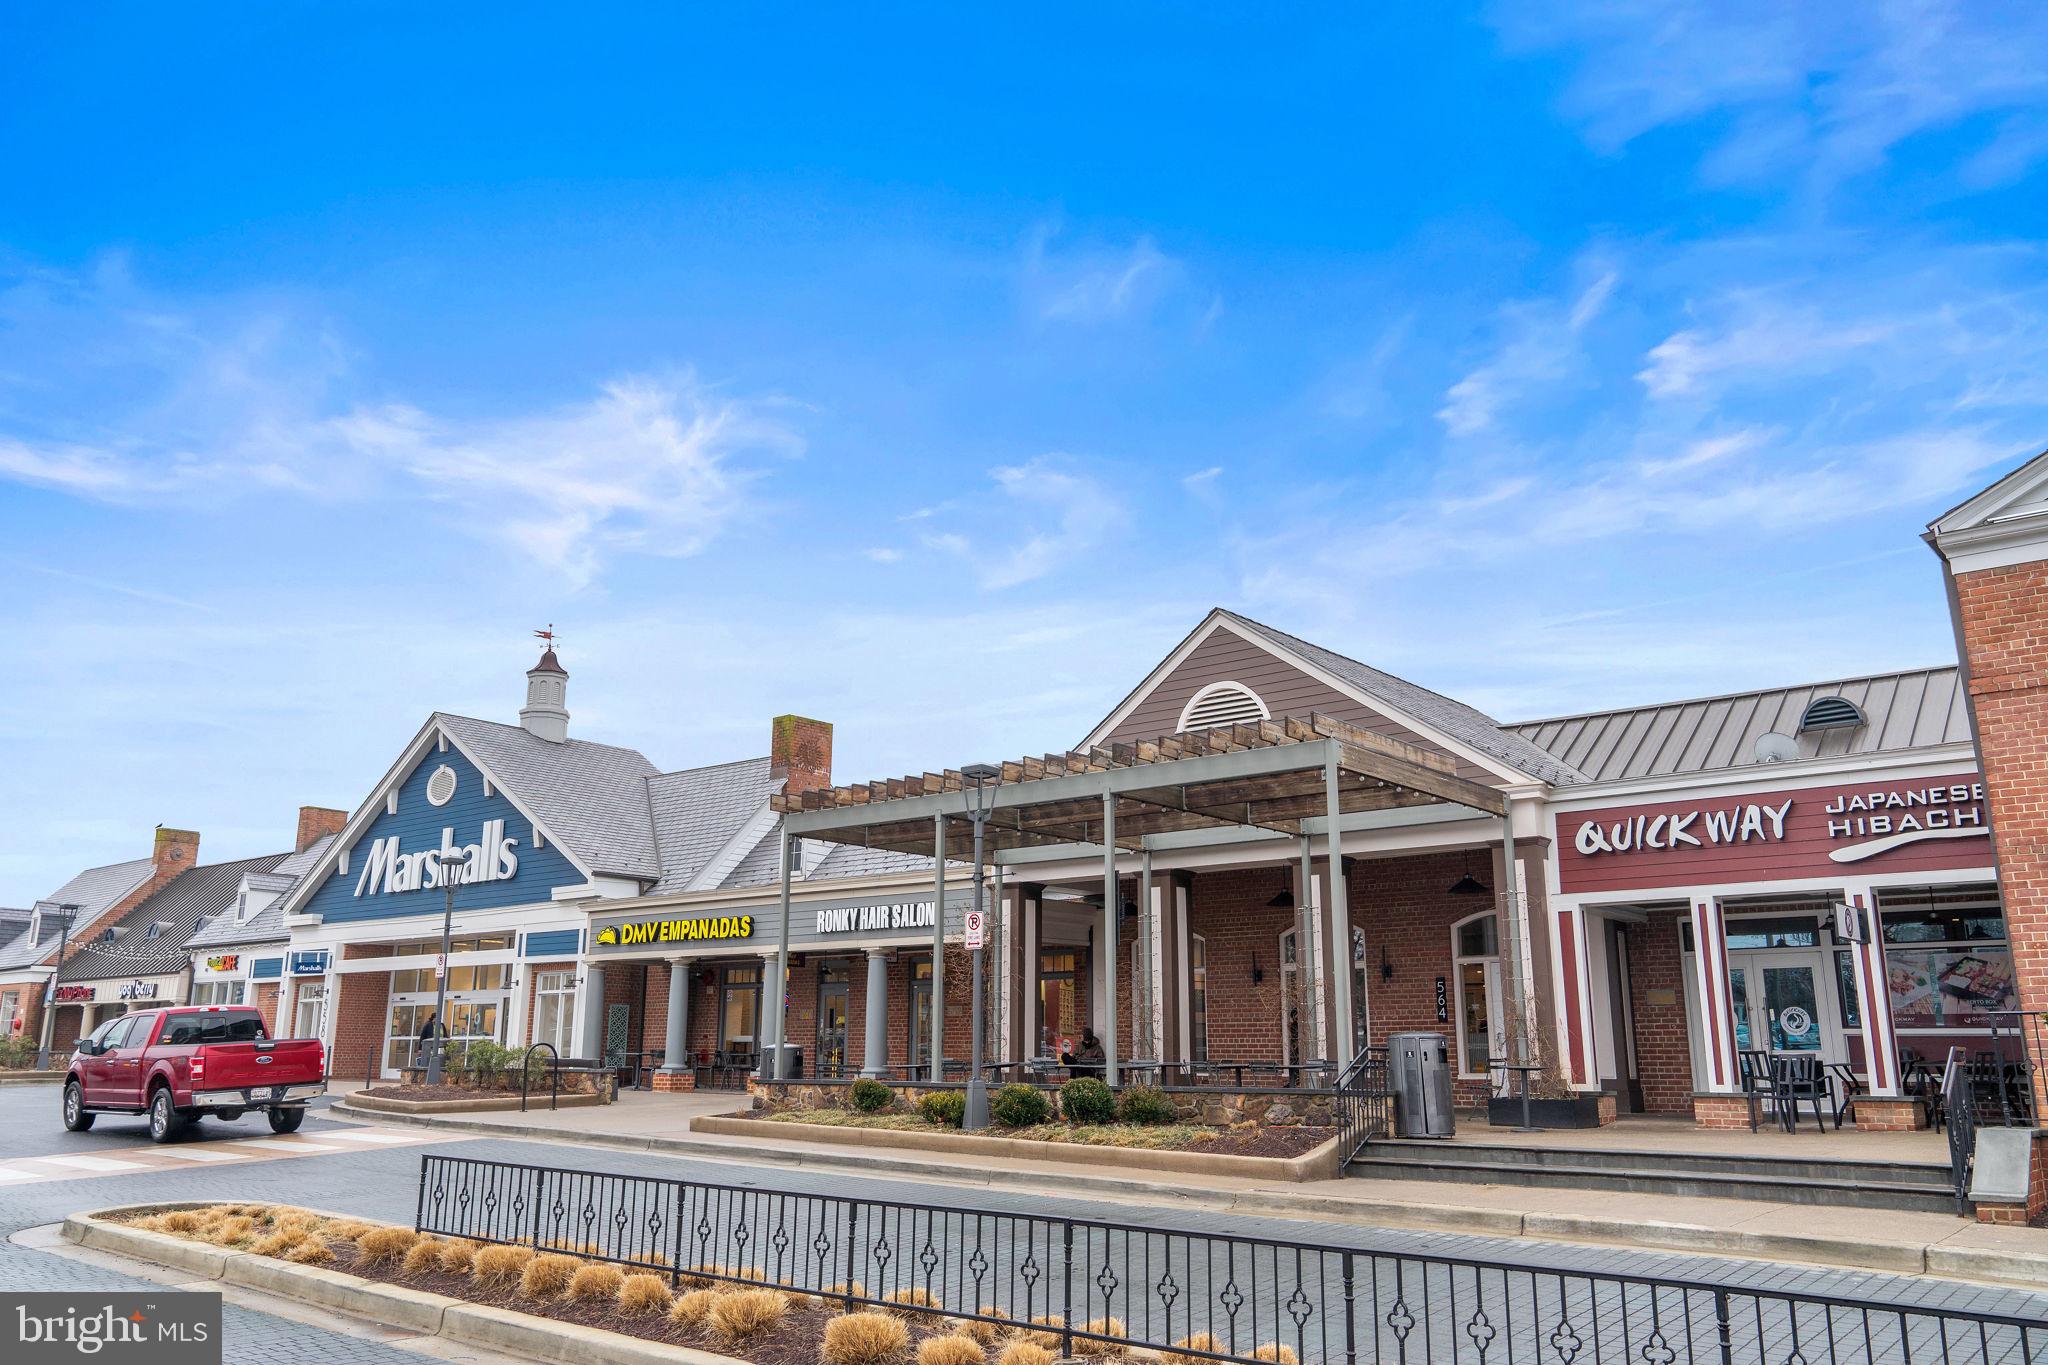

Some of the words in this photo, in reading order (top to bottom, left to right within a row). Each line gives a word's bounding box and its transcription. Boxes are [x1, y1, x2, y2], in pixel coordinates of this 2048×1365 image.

[353, 819, 519, 897] Marshalls
[621, 922, 659, 944] DMV
[659, 915, 752, 941] EMPANADAS
[816, 907, 859, 932] RONKY
[859, 905, 889, 930] HAIR
[891, 901, 936, 928] SALON
[1436, 981, 1447, 1018] 564
